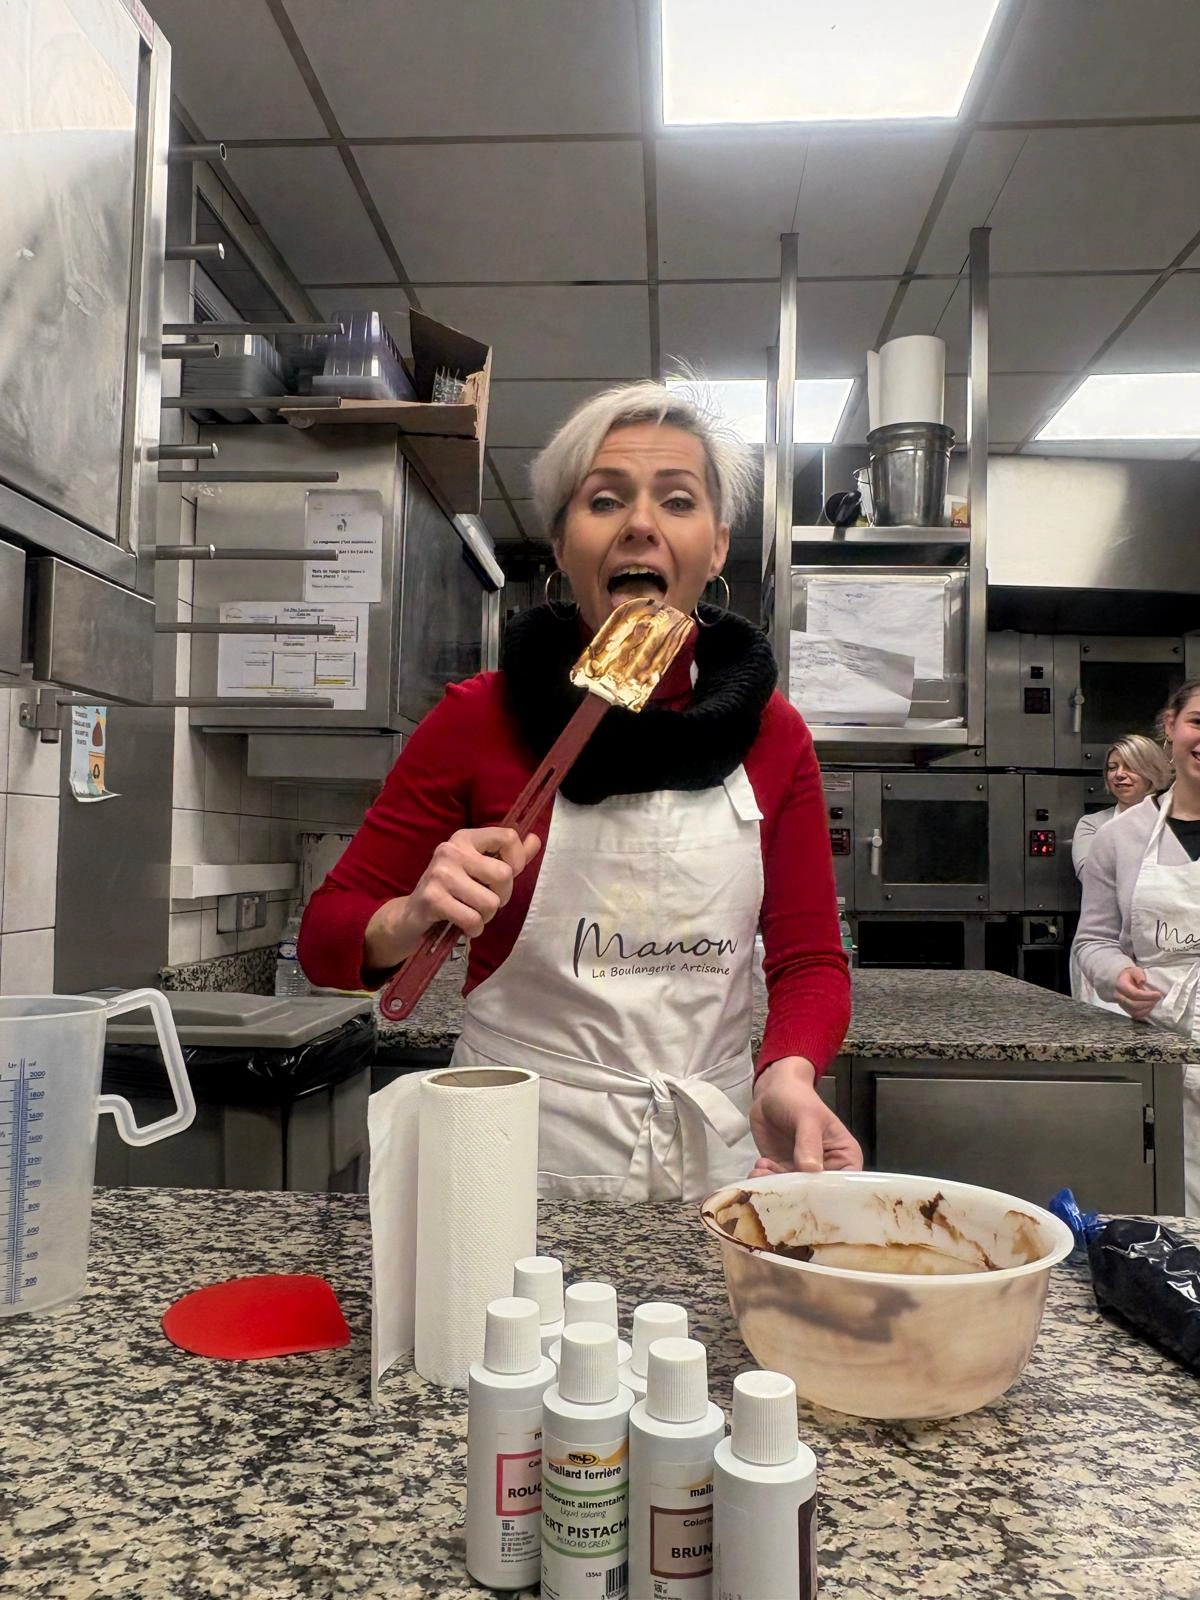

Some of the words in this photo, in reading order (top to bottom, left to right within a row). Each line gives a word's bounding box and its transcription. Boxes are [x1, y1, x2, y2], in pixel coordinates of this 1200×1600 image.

[1155, 919, 1200, 951] Ma
[573, 917, 739, 978] Manon
[592, 968, 606, 979] La
[610, 962, 676, 977] Boulangerie
[680, 962, 730, 976] Artisane
[548, 1462, 582, 1480] mallard
[584, 1465, 622, 1480] ferrière
[545, 1488, 576, 1508] Colorant
[567, 1514, 629, 1539] PISTACH
